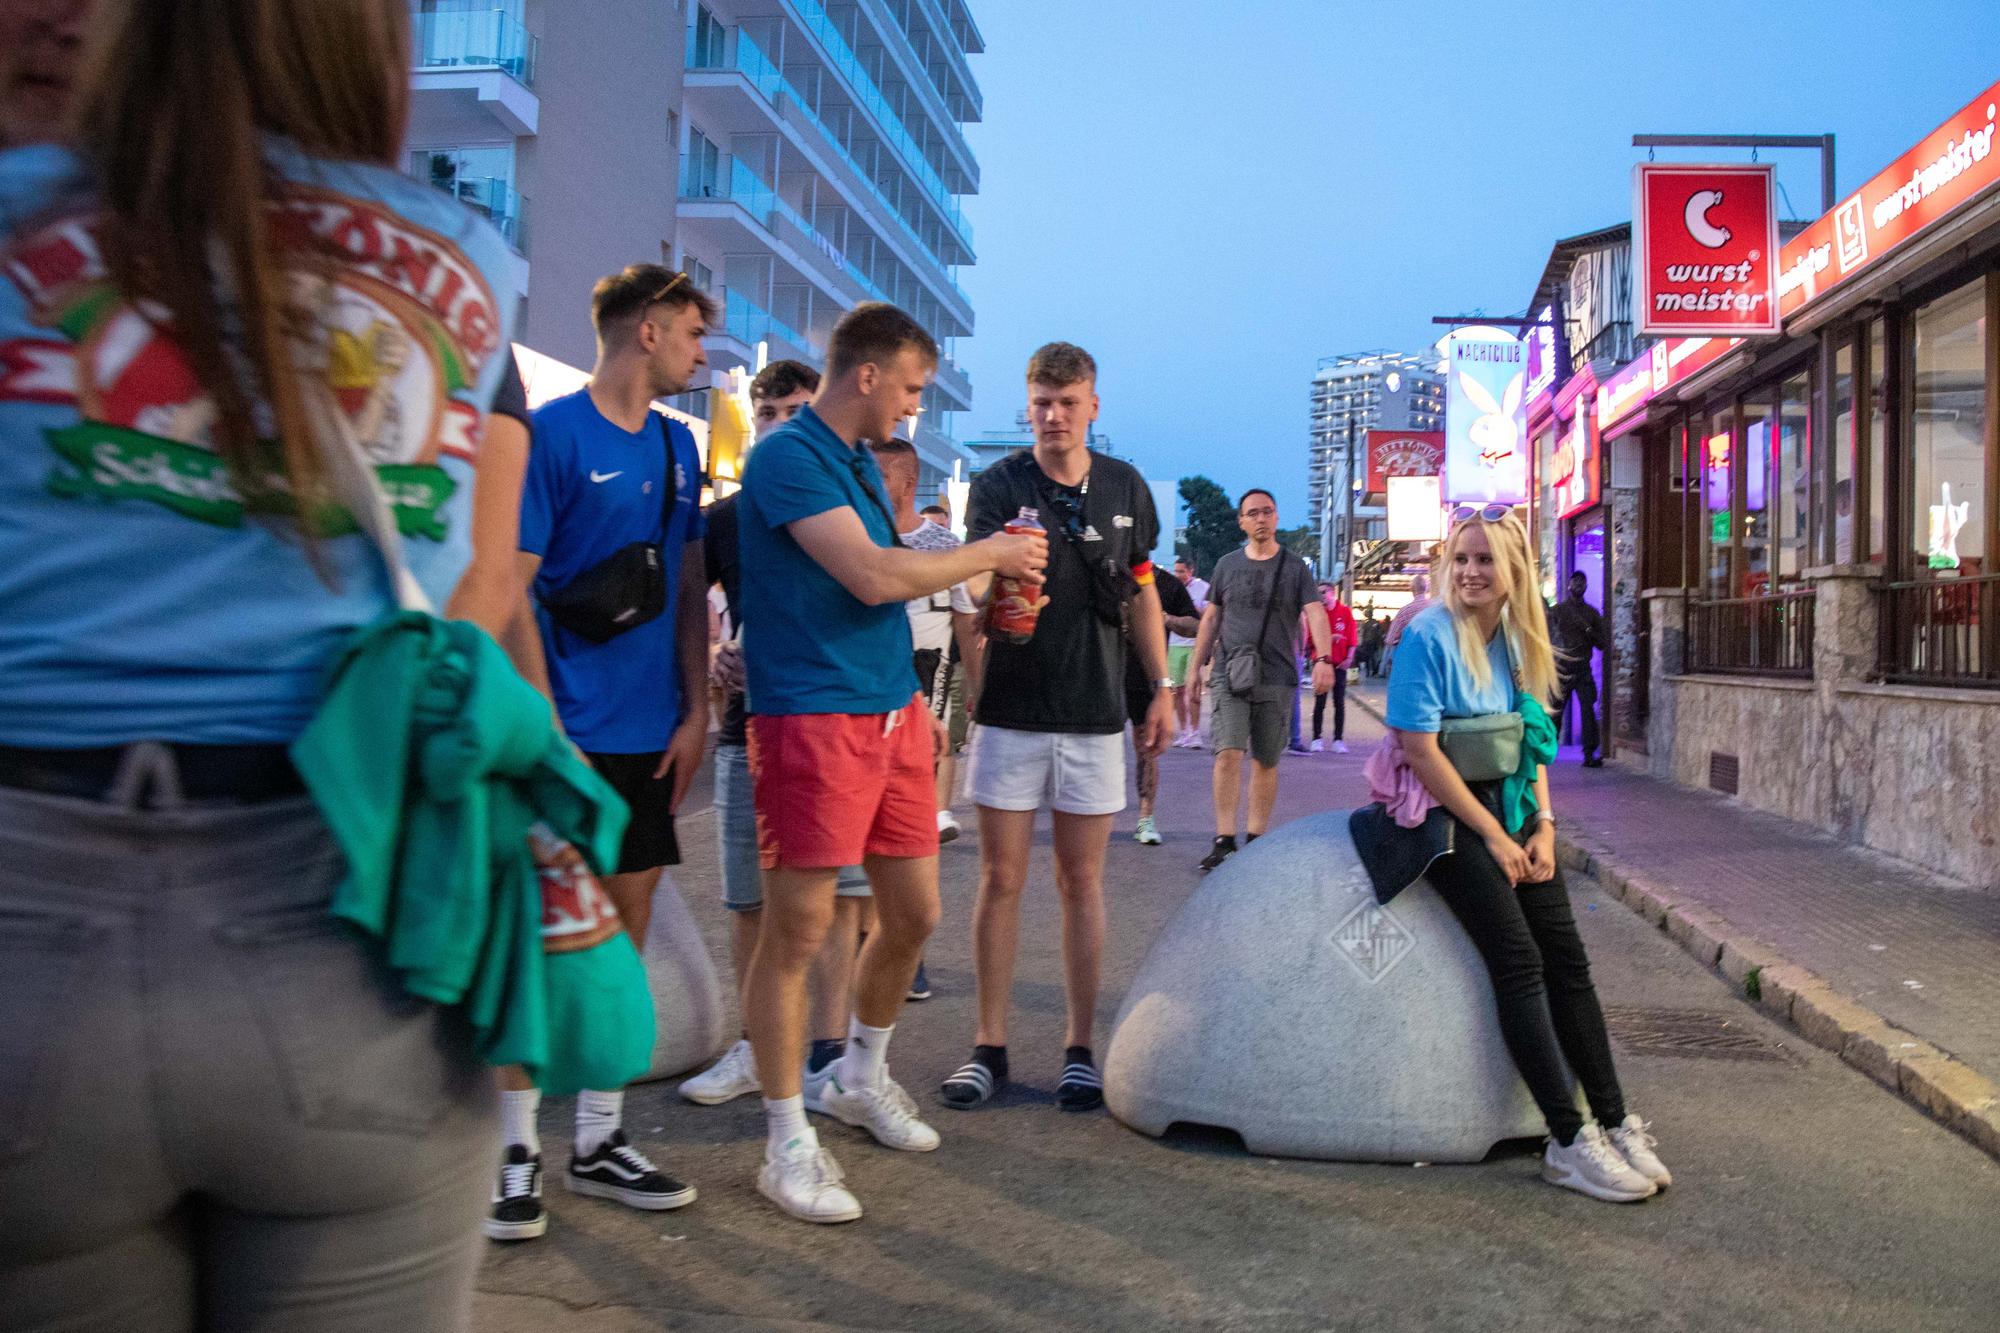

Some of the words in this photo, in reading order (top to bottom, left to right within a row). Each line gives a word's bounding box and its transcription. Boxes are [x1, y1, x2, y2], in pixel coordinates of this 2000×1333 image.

[1666, 260, 1753, 282] wurst
[1656, 288, 1765, 311] meister
[1457, 344, 1520, 363] NACHTCLUB
